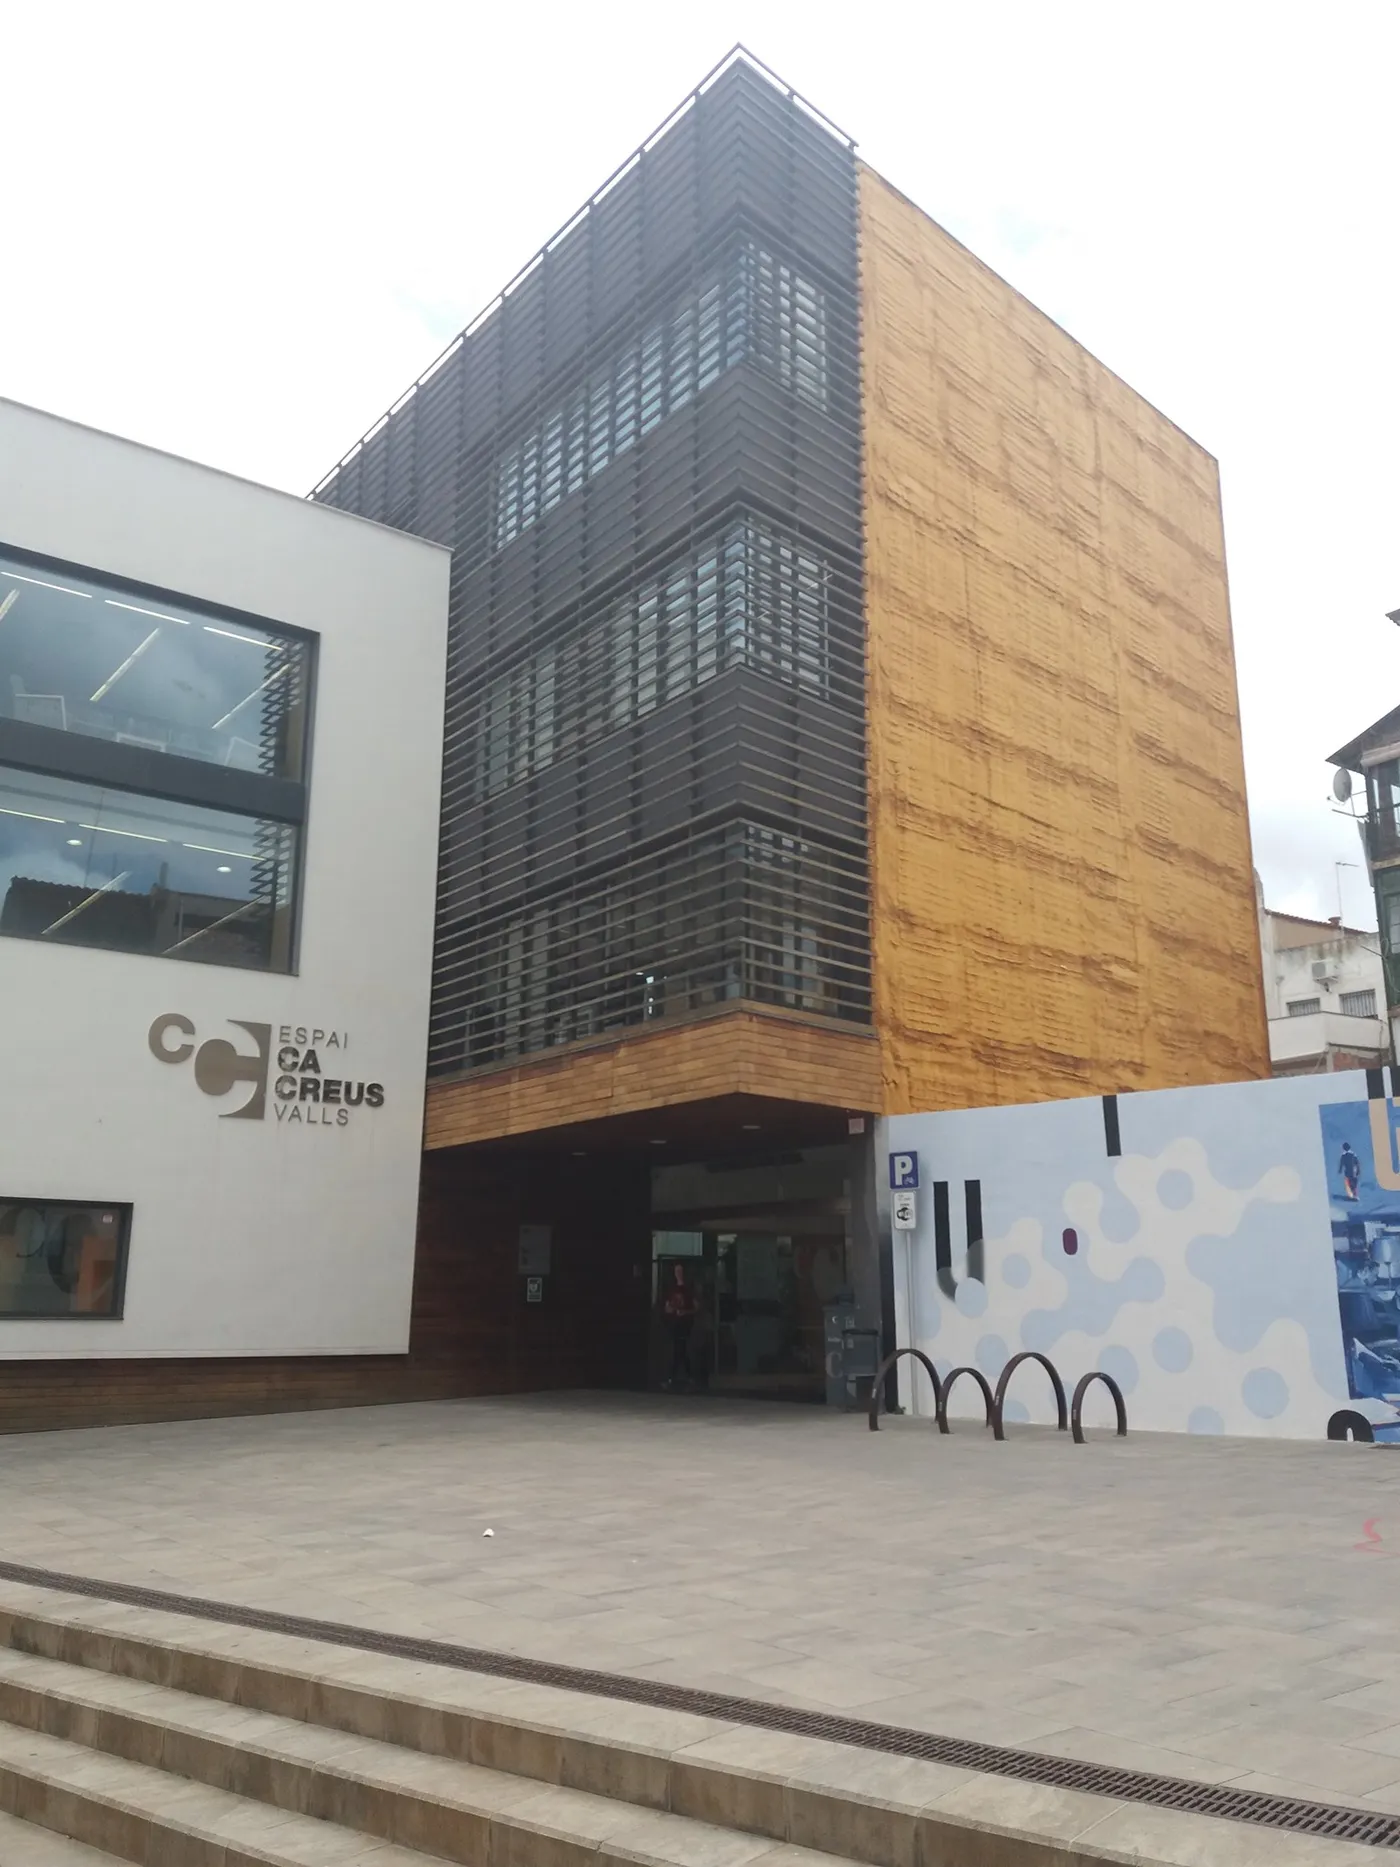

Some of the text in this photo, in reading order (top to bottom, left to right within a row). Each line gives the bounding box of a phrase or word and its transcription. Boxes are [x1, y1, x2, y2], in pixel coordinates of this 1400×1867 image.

[278, 1025, 349, 1049] ESPAI
[277, 1046, 321, 1074] CA
[274, 1074, 385, 1108] CREUS
[273, 1102, 349, 1127] VALLS
[894, 1155, 913, 1186] P
